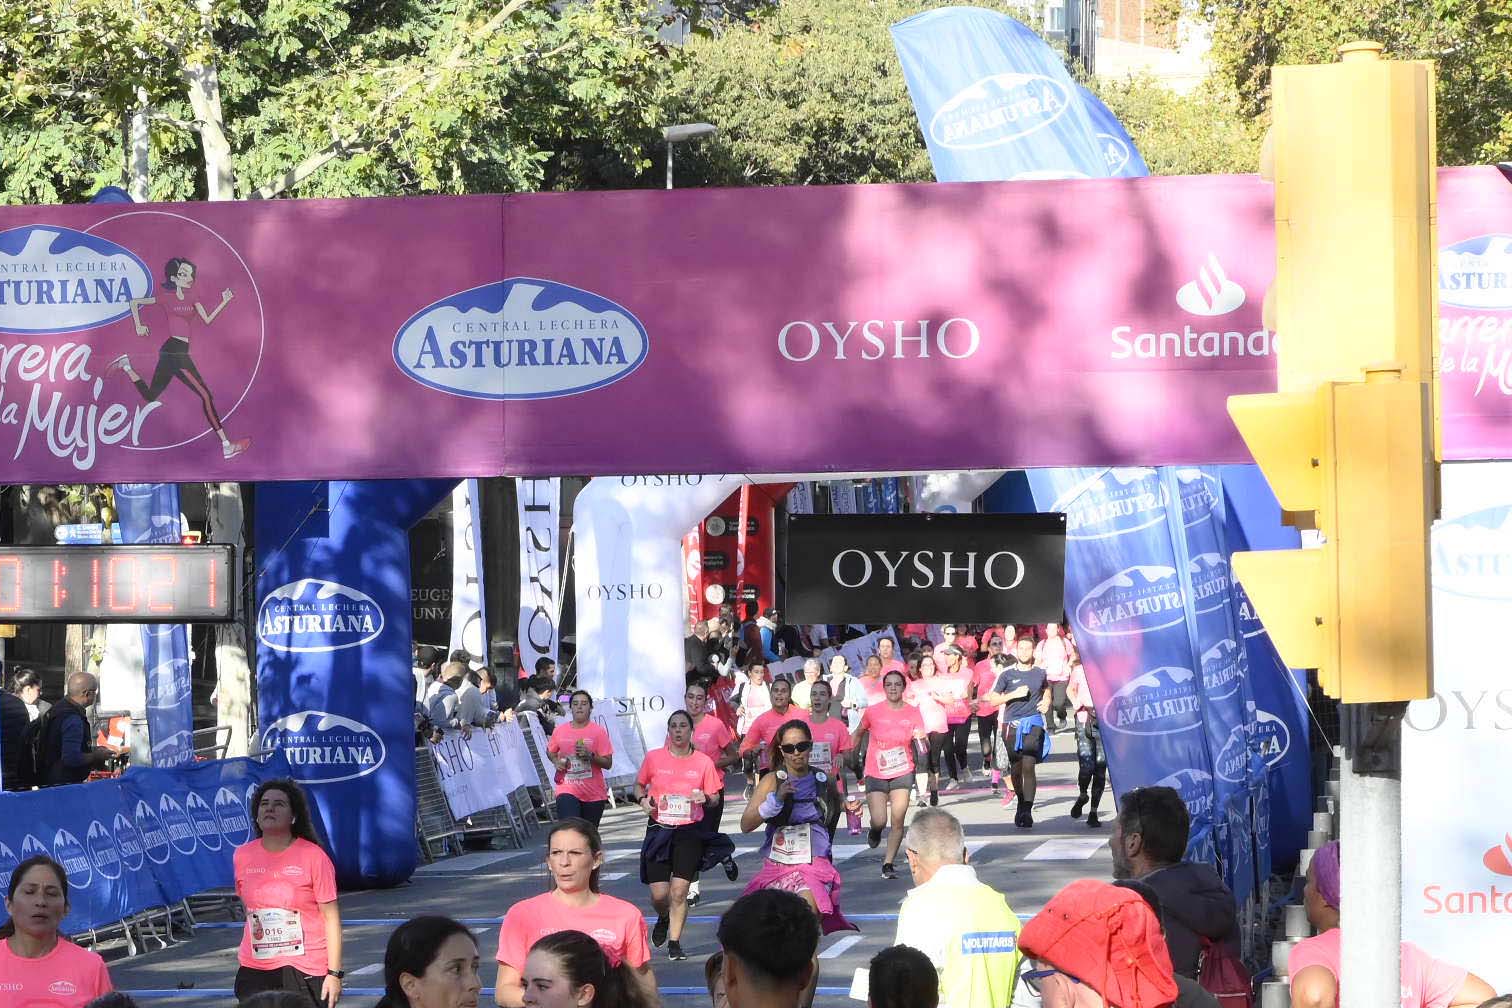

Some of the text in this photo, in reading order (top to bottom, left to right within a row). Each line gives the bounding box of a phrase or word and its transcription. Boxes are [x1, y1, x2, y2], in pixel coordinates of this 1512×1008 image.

[56, 261, 129, 273] LECHERA
[453, 318, 620, 333] CENTRAL LECHERA
[413, 325, 628, 370] ASTURIANA
[777, 317, 980, 362] OYSHO
[13, 376, 163, 470] Mujer
[831, 549, 1026, 590] OYSHO
[587, 583, 663, 601] OYSHO
[275, 603, 370, 613] CENTRAL LECHERA
[262, 609, 376, 636] ASTURIANA
[265, 928, 283, 936] 016
